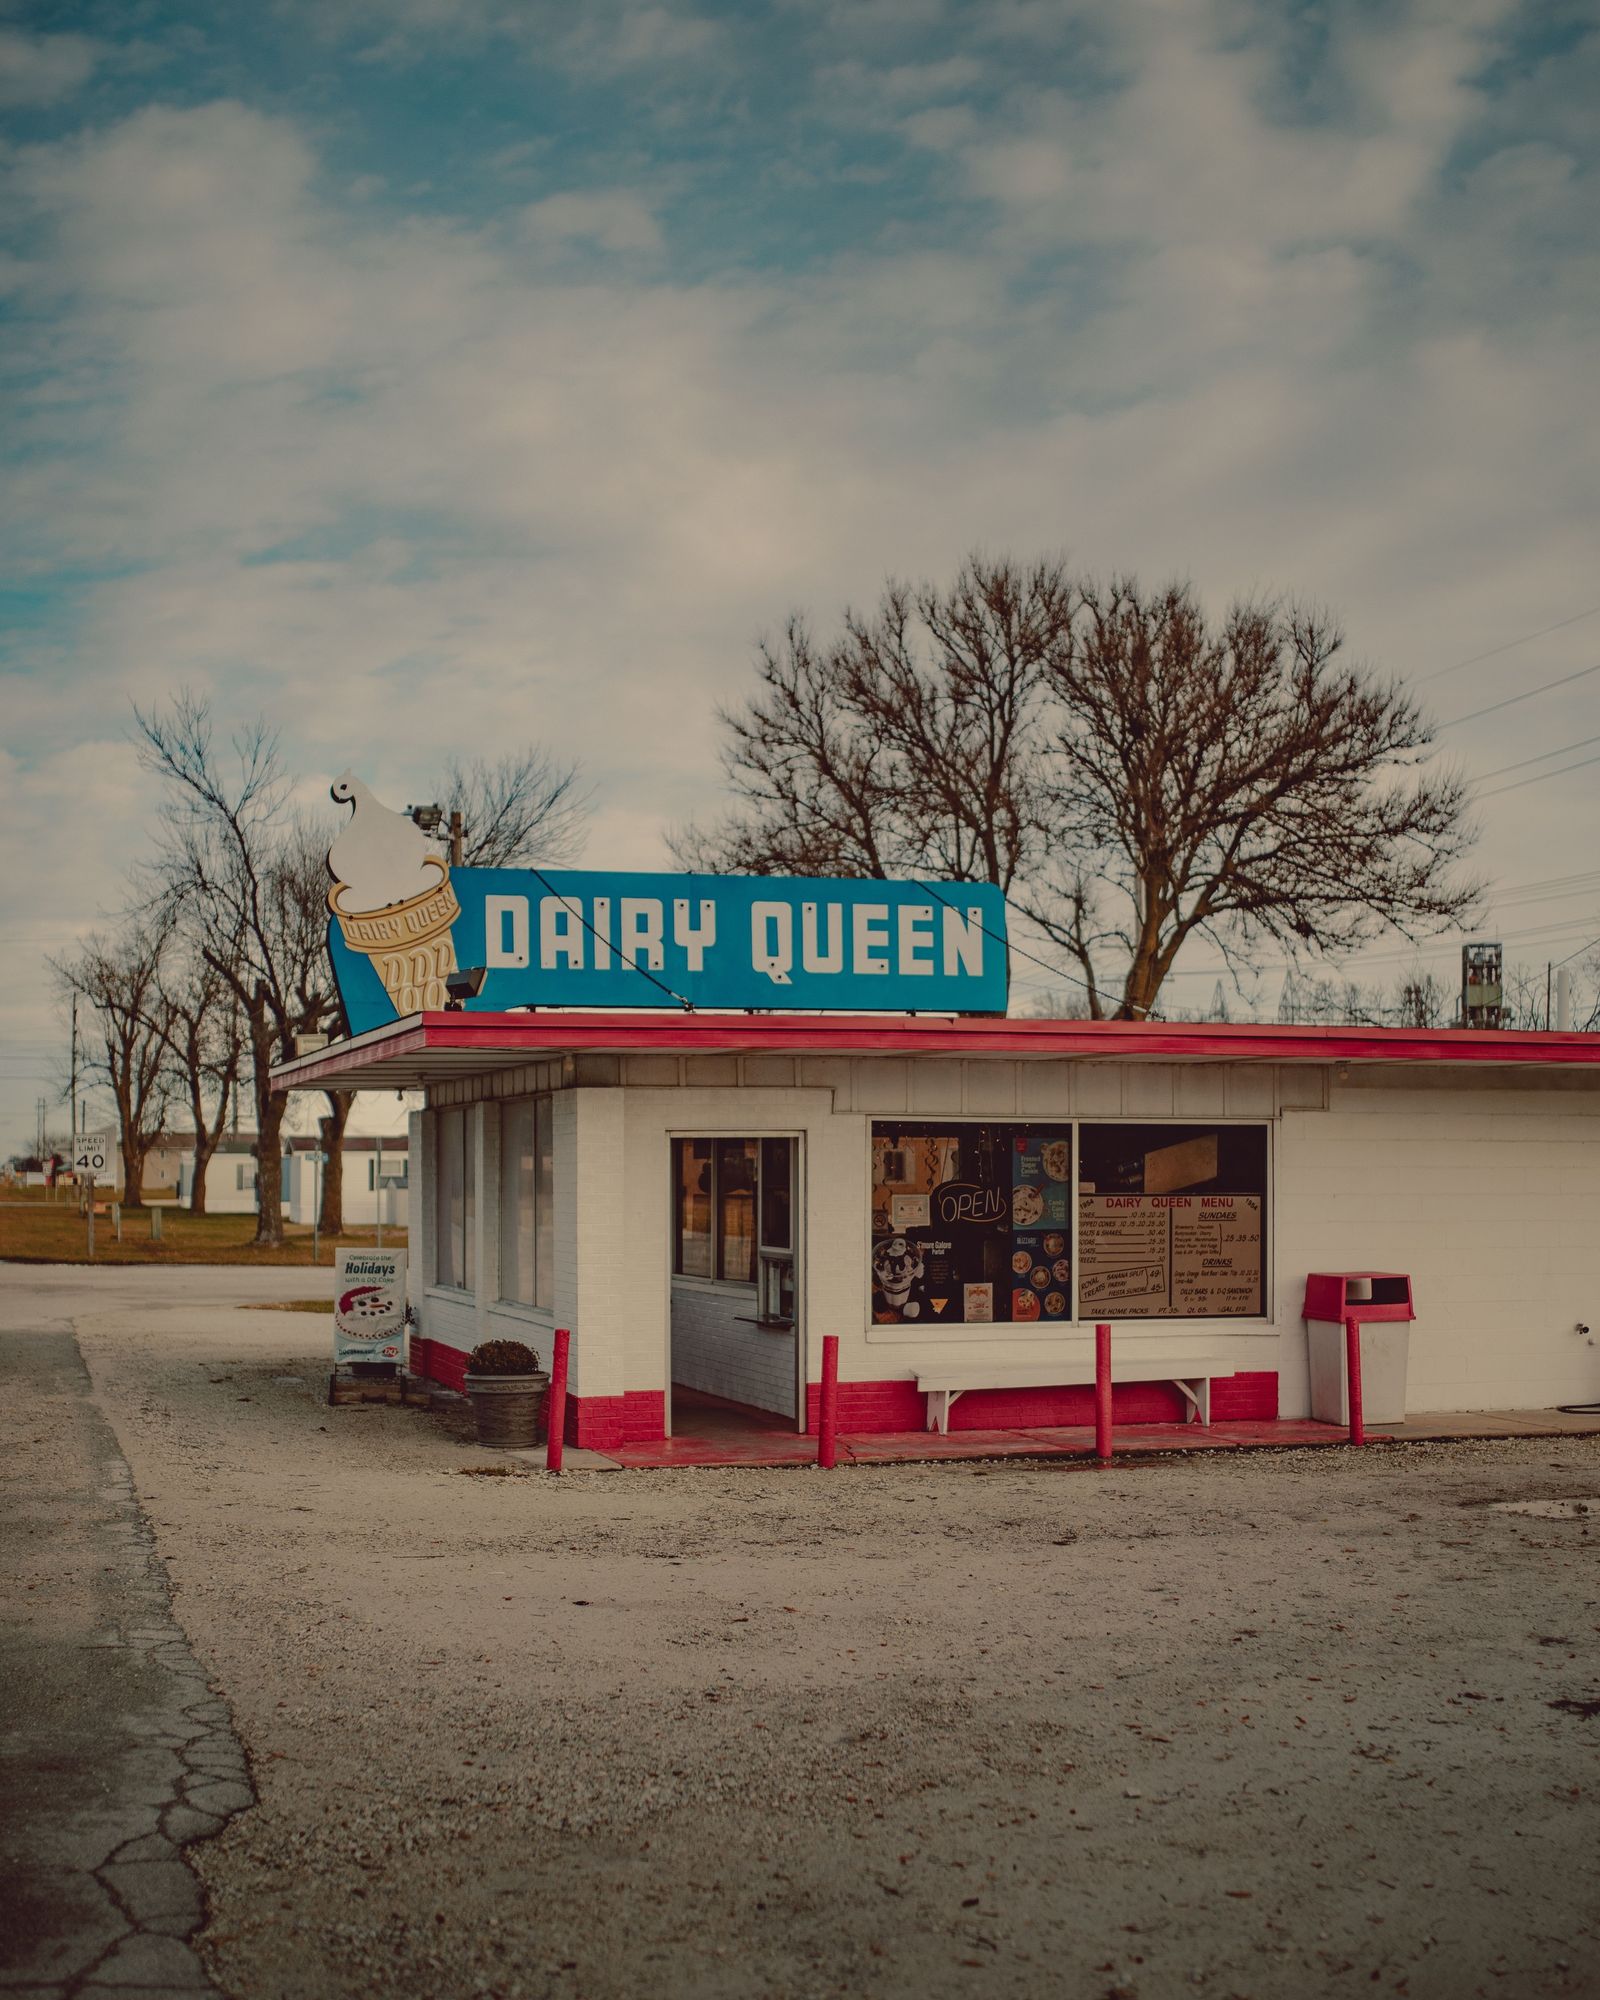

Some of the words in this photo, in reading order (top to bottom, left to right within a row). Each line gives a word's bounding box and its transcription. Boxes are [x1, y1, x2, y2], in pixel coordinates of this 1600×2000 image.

[344, 918, 400, 940] DAIRY
[405, 891, 455, 933] QUEEN
[485, 894, 716, 971] DAIRY
[751, 900, 984, 985] QUEEN
[76, 1154, 104, 1168] 40
[942, 1187, 1000, 1221] OPEN
[1080, 1198, 1094, 1209] 1954
[1106, 1198, 1141, 1207] DAIRY
[1152, 1198, 1191, 1208] QUEEN
[1202, 1198, 1233, 1207] MENU
[1246, 1198, 1258, 1211] 1954
[1248, 1234, 1259, 1242] .50
[345, 1262, 395, 1276] Holidays
[1129, 1270, 1144, 1278] SPLIT
[1081, 1277, 1099, 1290] ROYAL
[1084, 1283, 1105, 1299] TREATS
